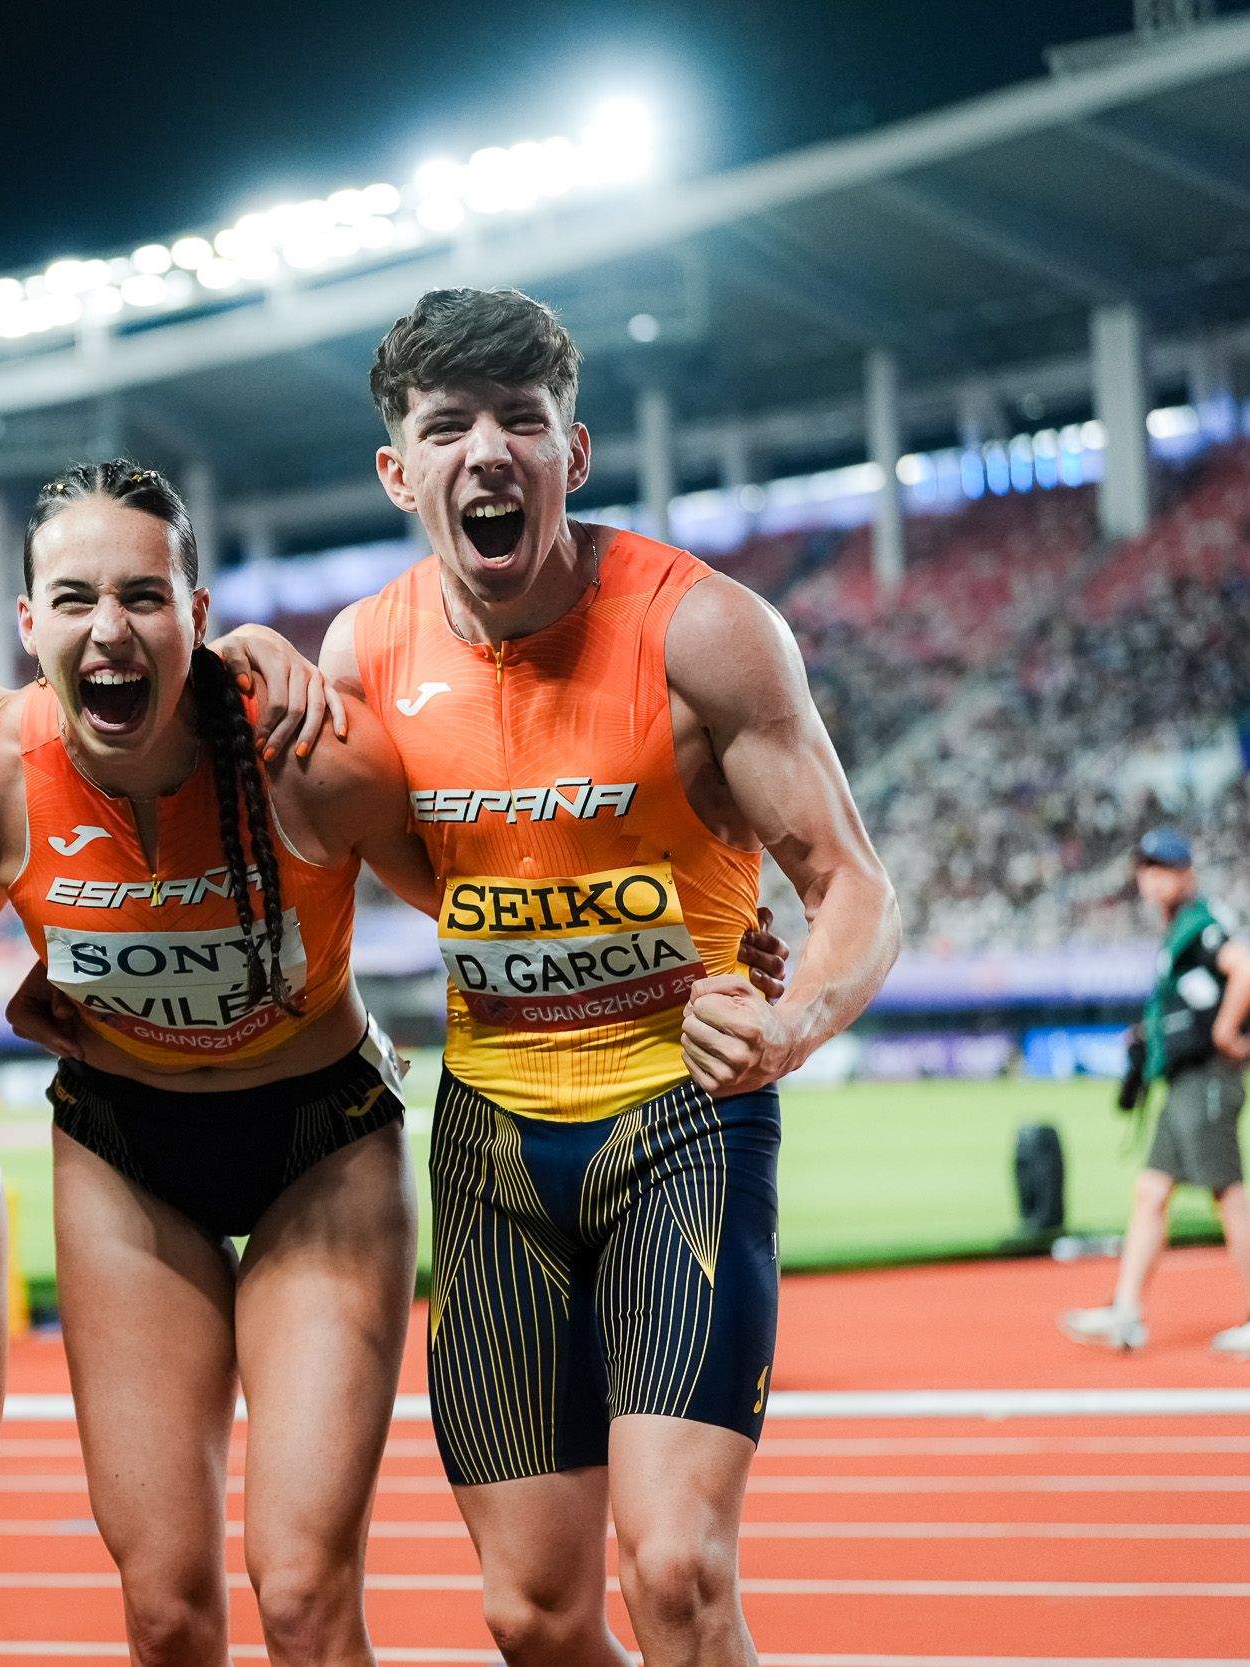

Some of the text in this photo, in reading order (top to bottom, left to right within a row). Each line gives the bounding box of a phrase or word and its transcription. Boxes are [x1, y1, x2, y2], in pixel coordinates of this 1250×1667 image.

[410, 777, 638, 824] ESPAÑA
[447, 875, 668, 932] SEIKO
[70, 931, 268, 977] SONY
[455, 933, 688, 994] D. GARCÍA
[82, 977, 293, 1027] AVILÉ
[521, 985, 665, 1023] GUANGZHOU
[134, 1012, 270, 1050] GUANGZHOU
